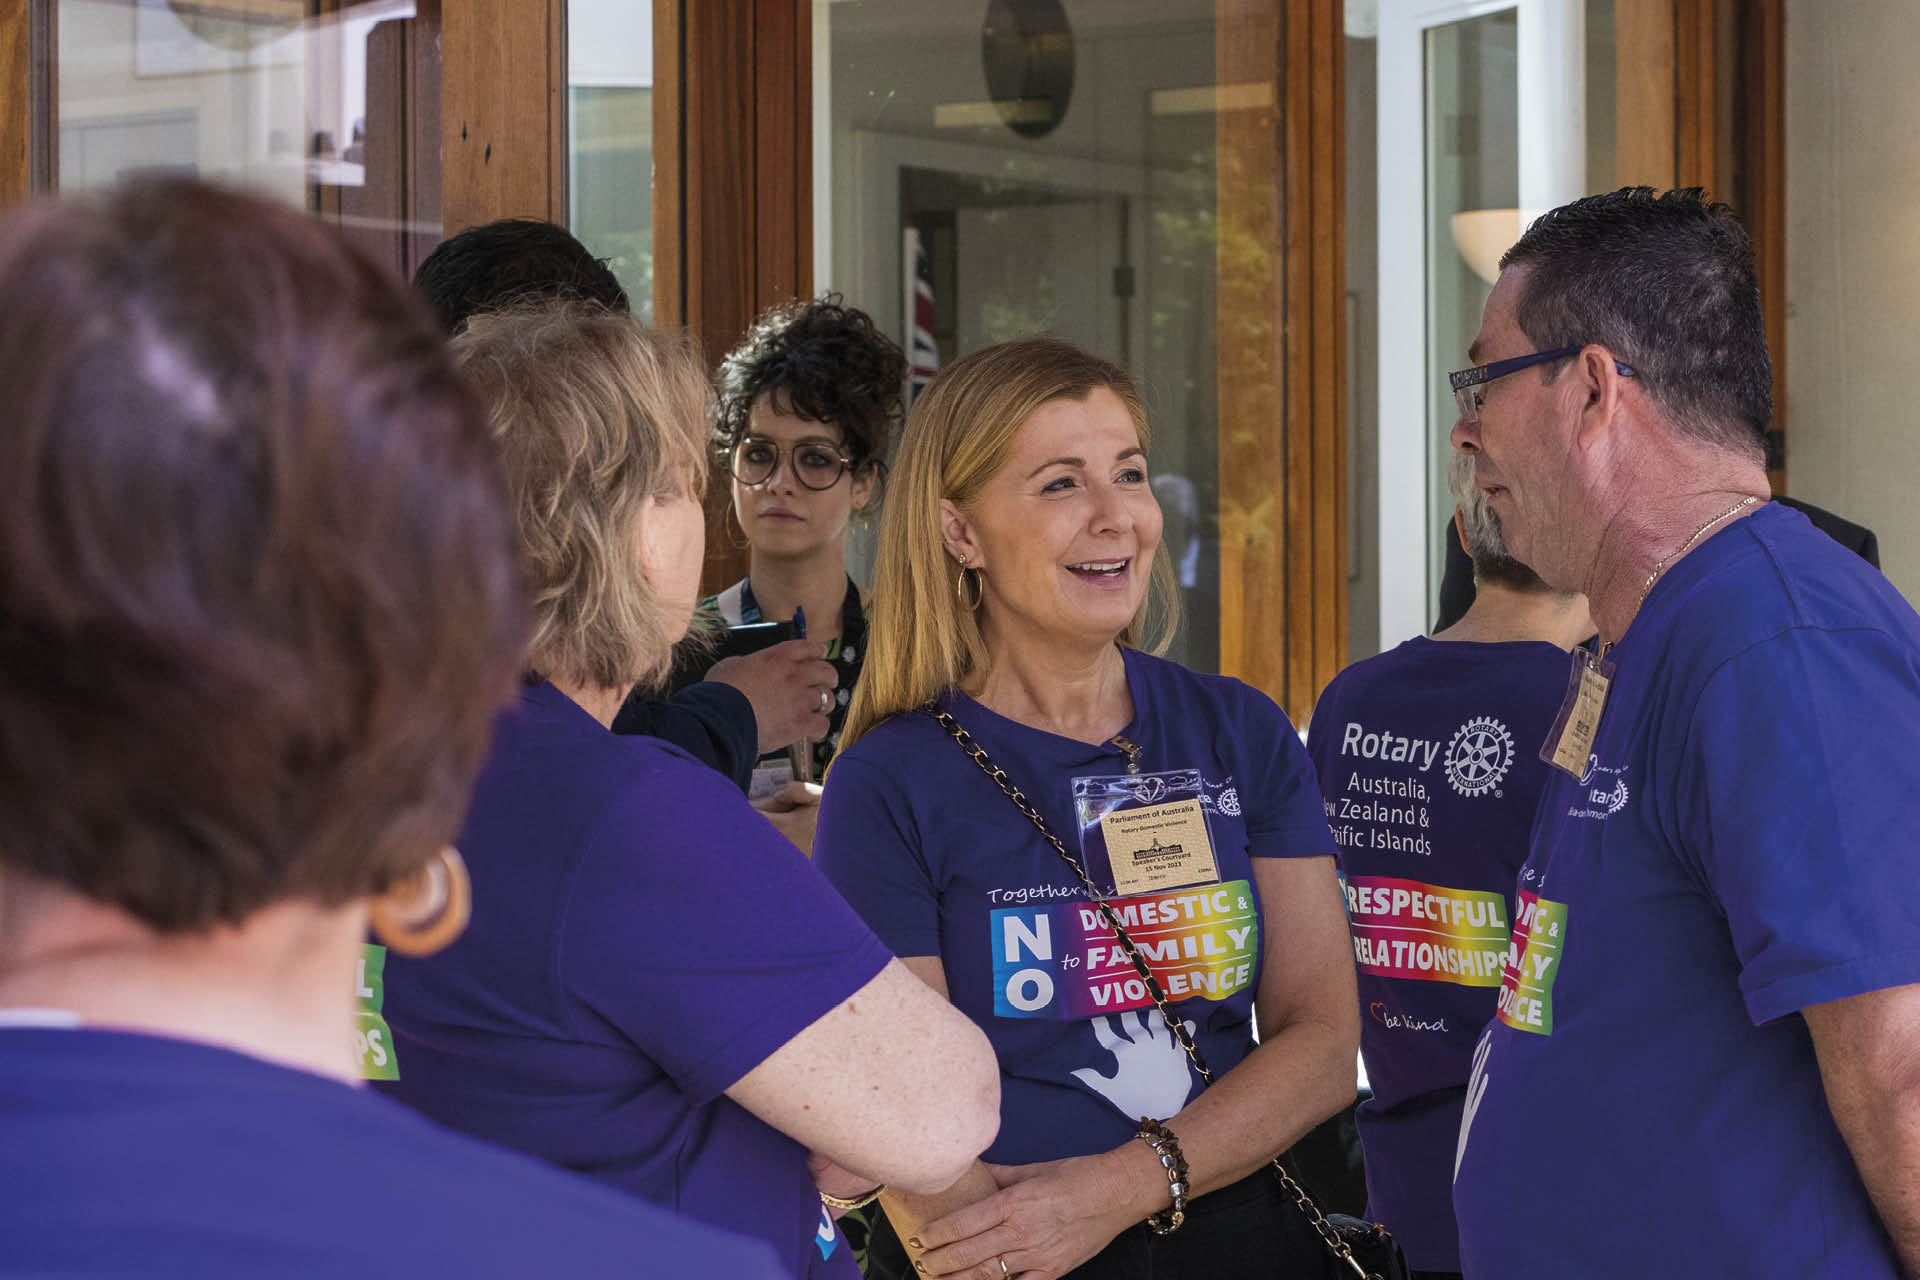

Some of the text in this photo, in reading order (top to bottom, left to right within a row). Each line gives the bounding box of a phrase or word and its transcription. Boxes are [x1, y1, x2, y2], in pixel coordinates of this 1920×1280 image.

[1470, 725, 1499, 736] ROTARY
[1341, 722, 1440, 771] Rotary
[1347, 771, 1431, 803] Australia,
[1110, 811, 1150, 824] Parliament
[1152, 809, 1160, 818] of
[1161, 805, 1194, 816] Australia
[1340, 798, 1415, 825] Zealand
[1420, 807, 1429, 828] &
[1121, 819, 1187, 834] Rotary Domestic Violence
[1371, 828, 1431, 856] Islands
[1132, 850, 1191, 865] Speaker's Courtyard
[1154, 862, 1166, 871] Nov
[1167, 861, 1183, 869] 2023
[986, 884, 1080, 904] Together
[1079, 890, 1231, 931] DOMESTIC
[1237, 896, 1248, 910] &
[1347, 885, 1504, 928] RESPECTFUL
[1549, 922, 1559, 937] &
[1087, 925, 1251, 970] FAMILY
[1060, 953, 1080, 970] to
[1089, 963, 1250, 1006] VIOENCE
[1384, 1011, 1449, 1032] be kind
